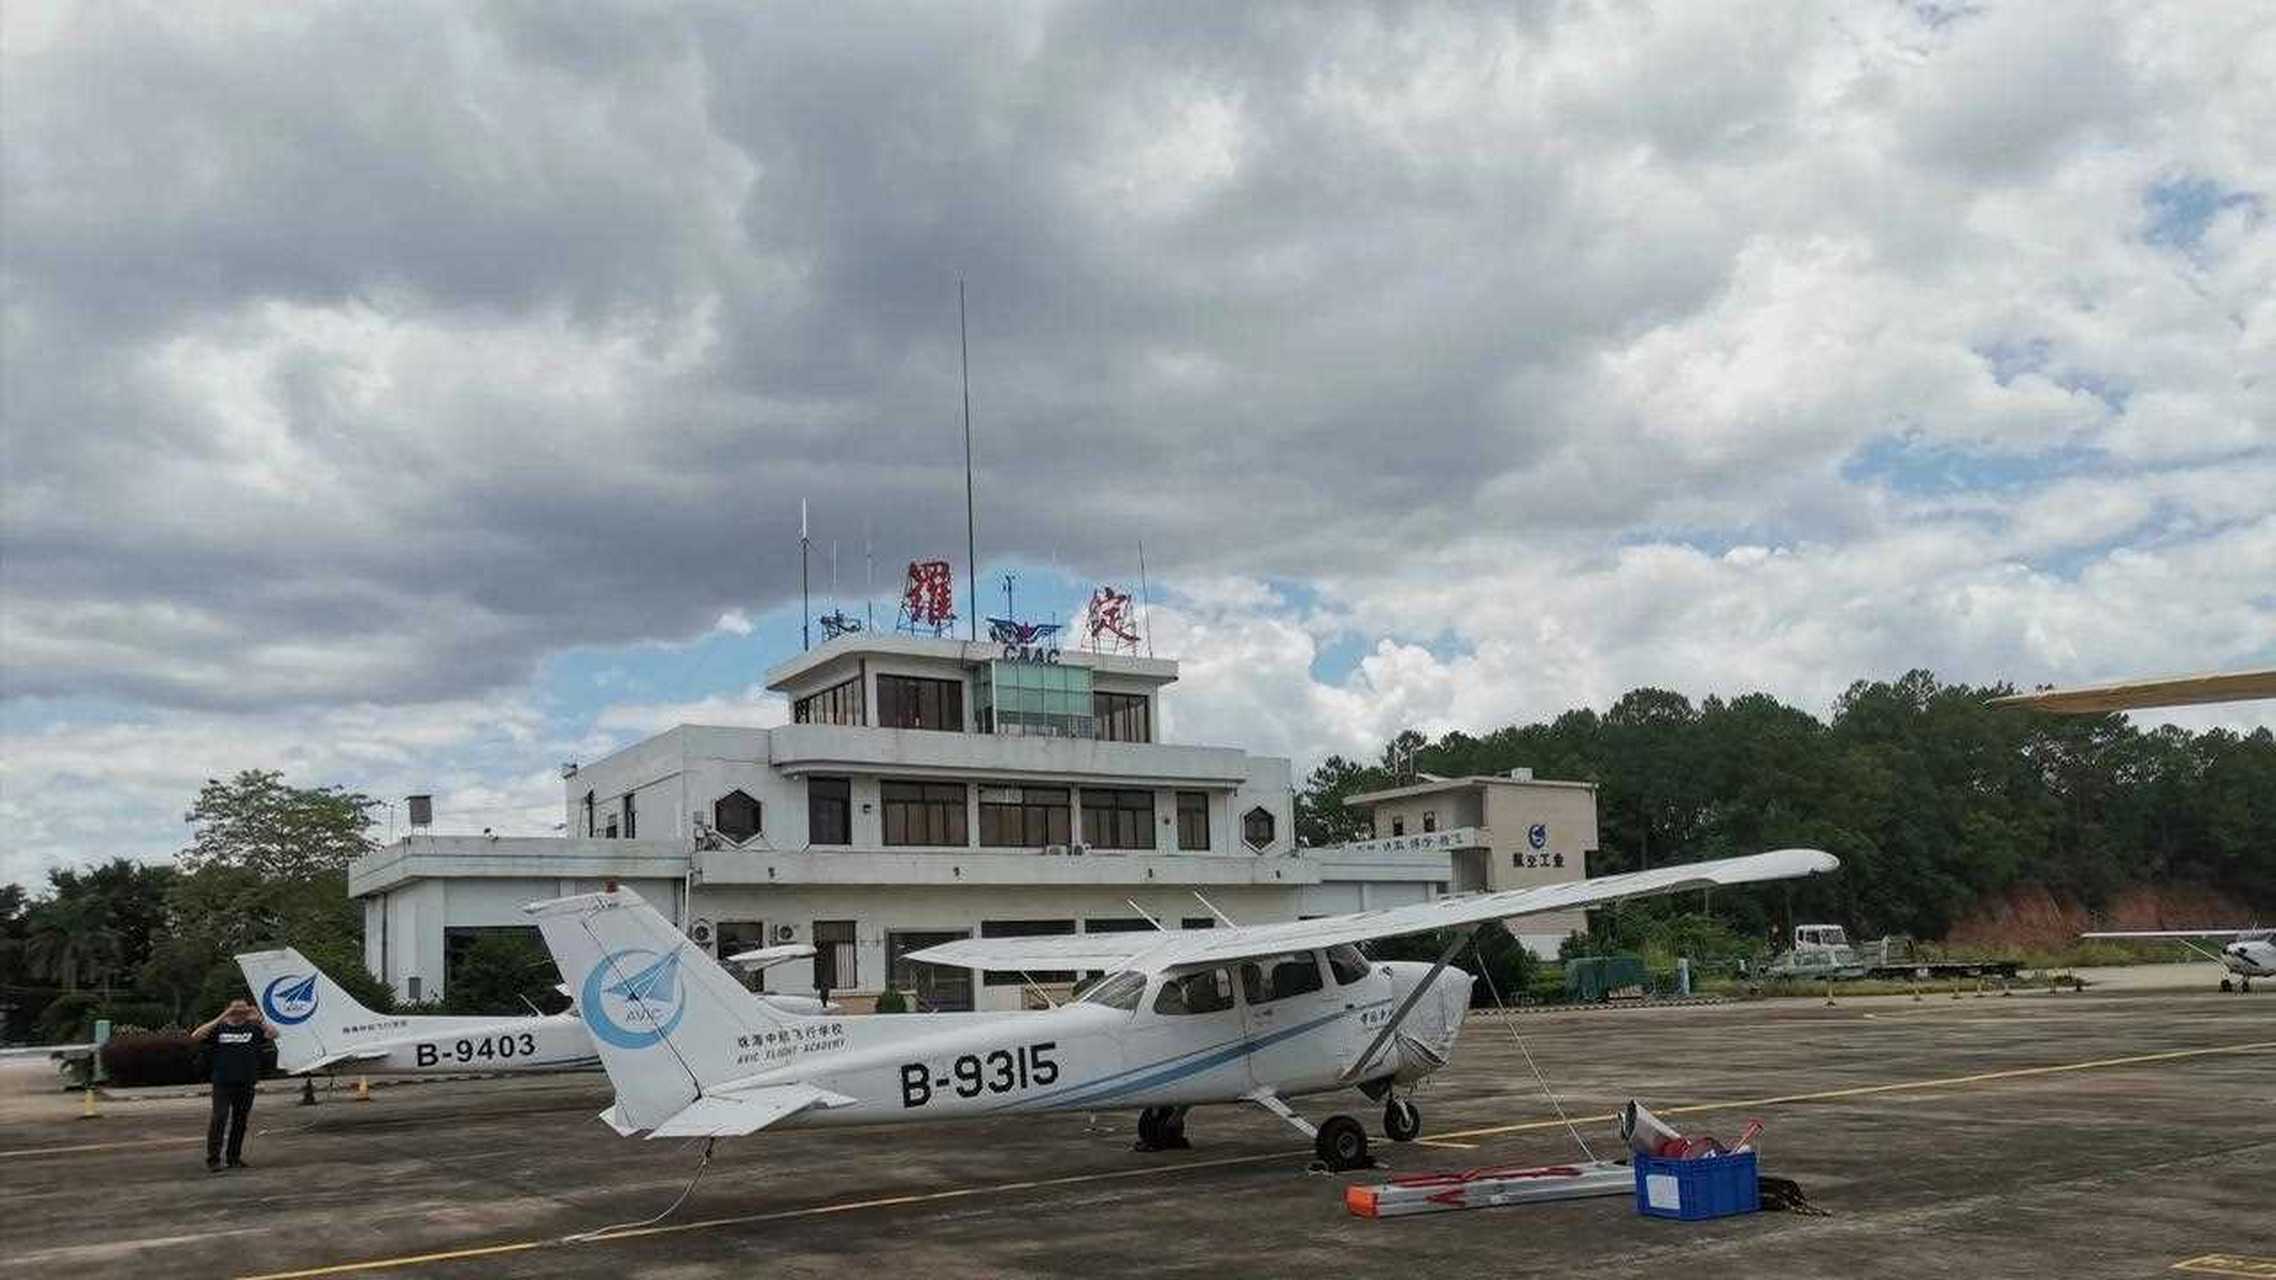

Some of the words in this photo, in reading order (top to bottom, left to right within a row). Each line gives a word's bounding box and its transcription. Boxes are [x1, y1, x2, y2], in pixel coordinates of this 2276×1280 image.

[1003, 646, 1060, 666] CAAC
[417, 1033, 535, 1066] B-9403
[901, 1042, 1058, 1108] B-9315
